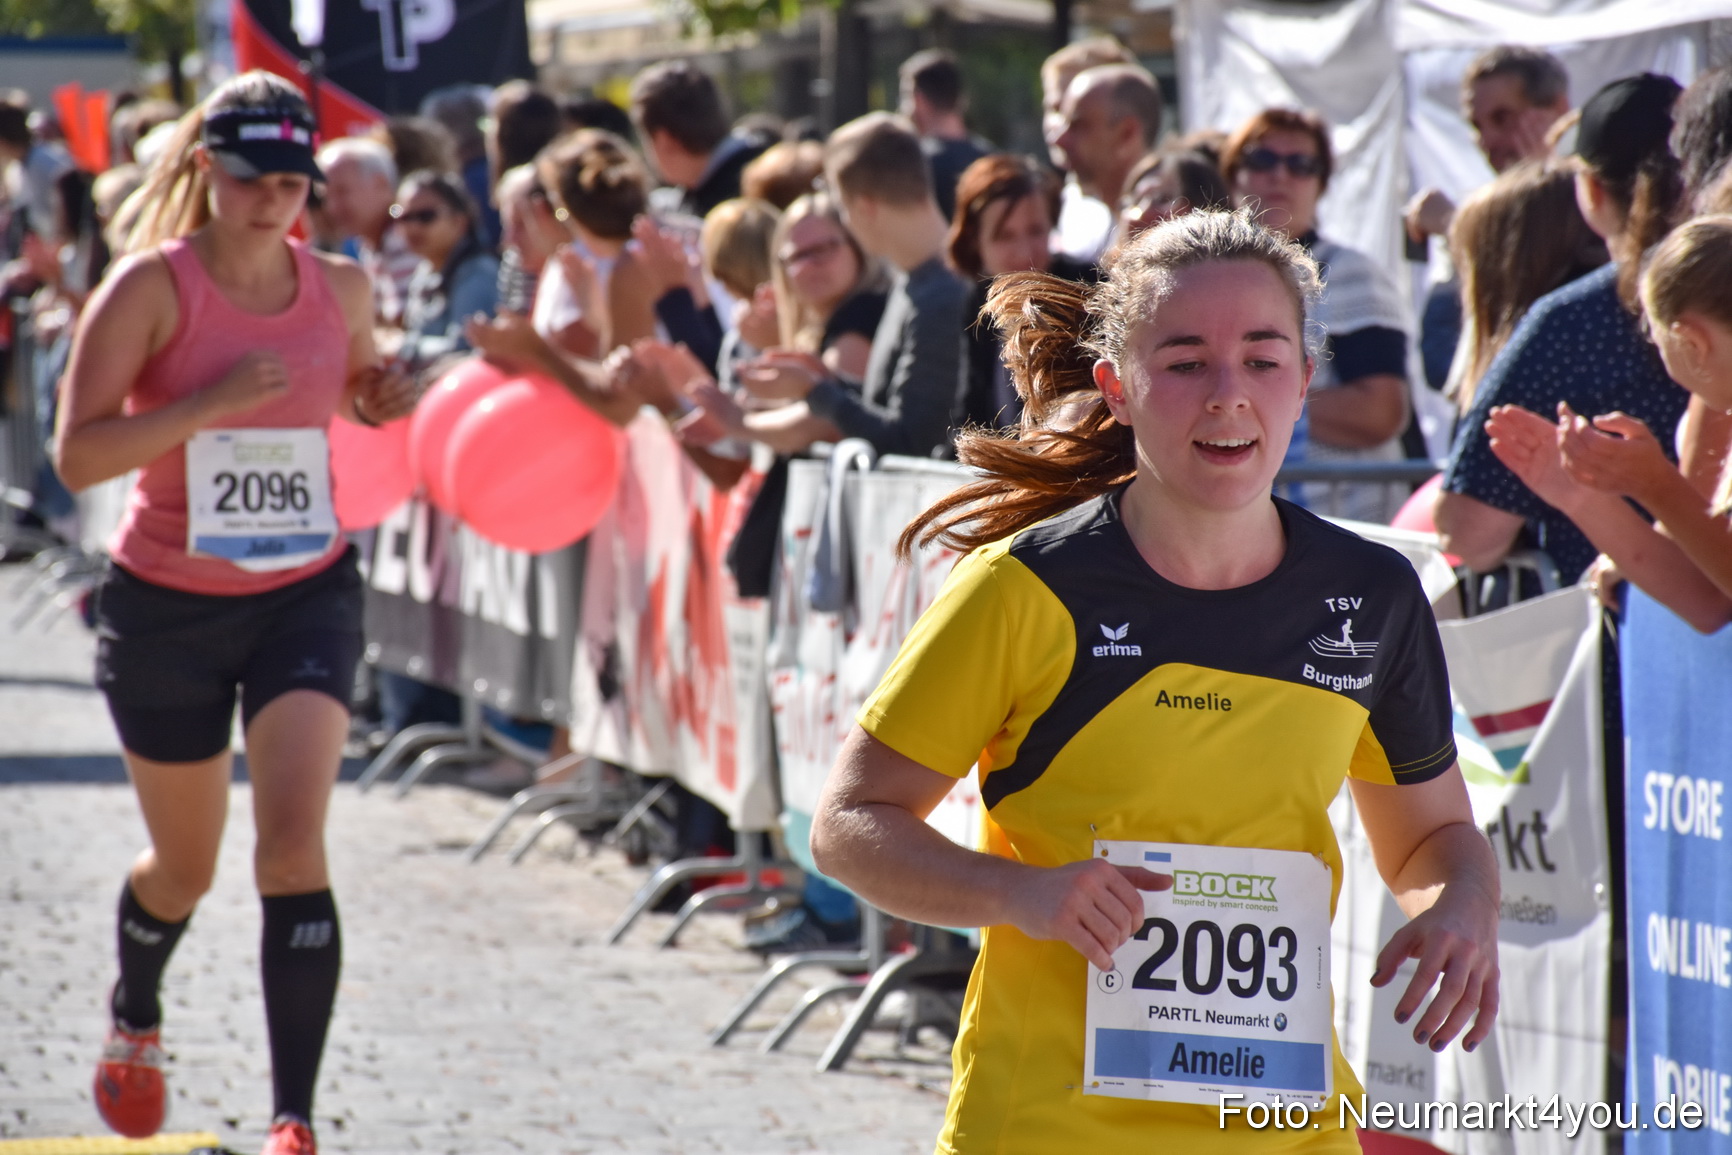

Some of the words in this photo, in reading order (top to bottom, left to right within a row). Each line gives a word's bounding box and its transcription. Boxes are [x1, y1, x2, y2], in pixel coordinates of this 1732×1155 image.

[213, 470, 312, 514] 2096
[1325, 597, 1363, 613] TSV
[1092, 642, 1142, 657] erima
[1302, 663, 1373, 692] Burgthann
[1155, 690, 1232, 712] Amelie
[1644, 770, 1724, 841] STORE
[1173, 870, 1278, 902] BOCK
[1172, 897, 1205, 907] inspired
[1207, 899, 1218, 909] by
[1220, 900, 1244, 910] smart
[1245, 903, 1279, 912] concepts
[1131, 917, 1298, 1002] 2093
[1647, 911, 1732, 988] ONLINE
[1105, 974, 1115, 988] C
[1148, 1005, 1202, 1023] PARTL
[1205, 1009, 1270, 1028] Neumarkt
[1168, 1042, 1266, 1079] Amelie
